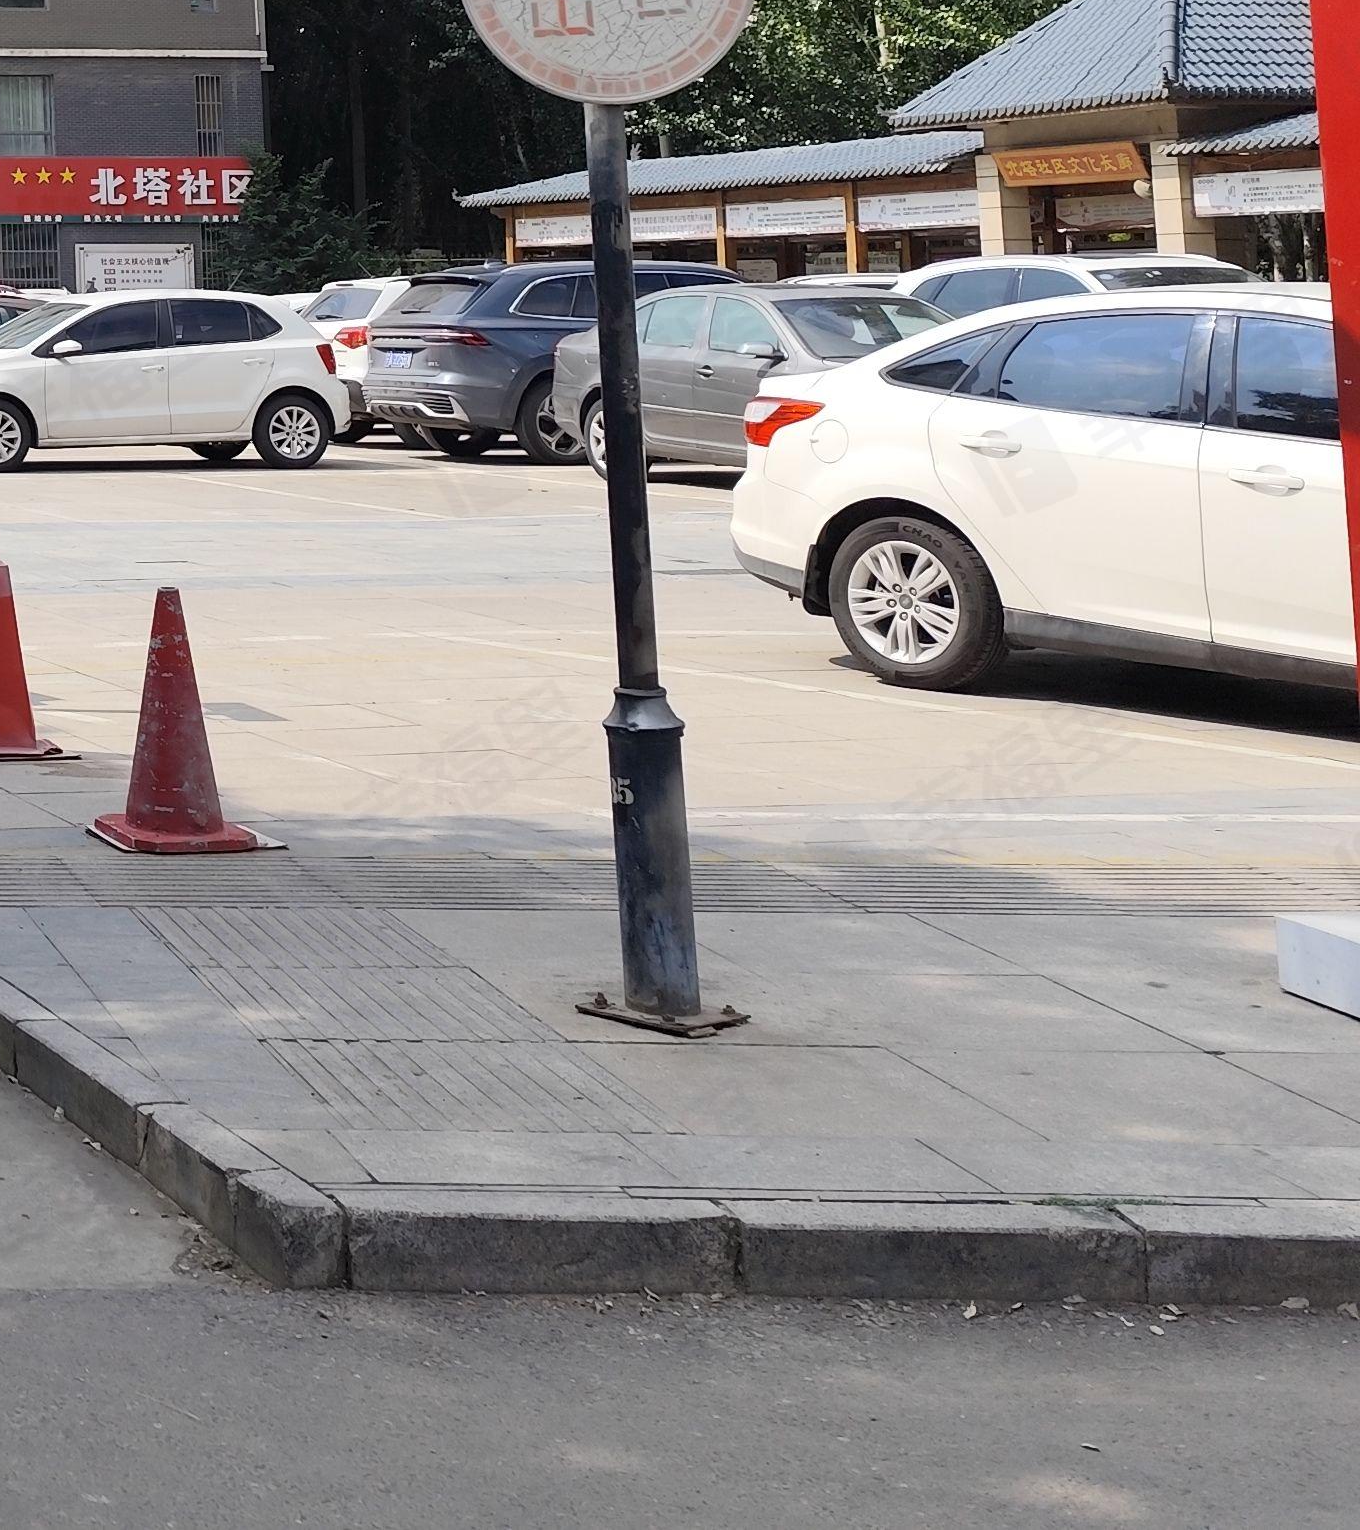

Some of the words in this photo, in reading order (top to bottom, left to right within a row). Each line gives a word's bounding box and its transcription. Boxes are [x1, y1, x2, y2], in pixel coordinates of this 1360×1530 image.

[1005, 153, 1134, 177] 北塔社区文化长廊
[89, 167, 255, 207] 北塔社区
